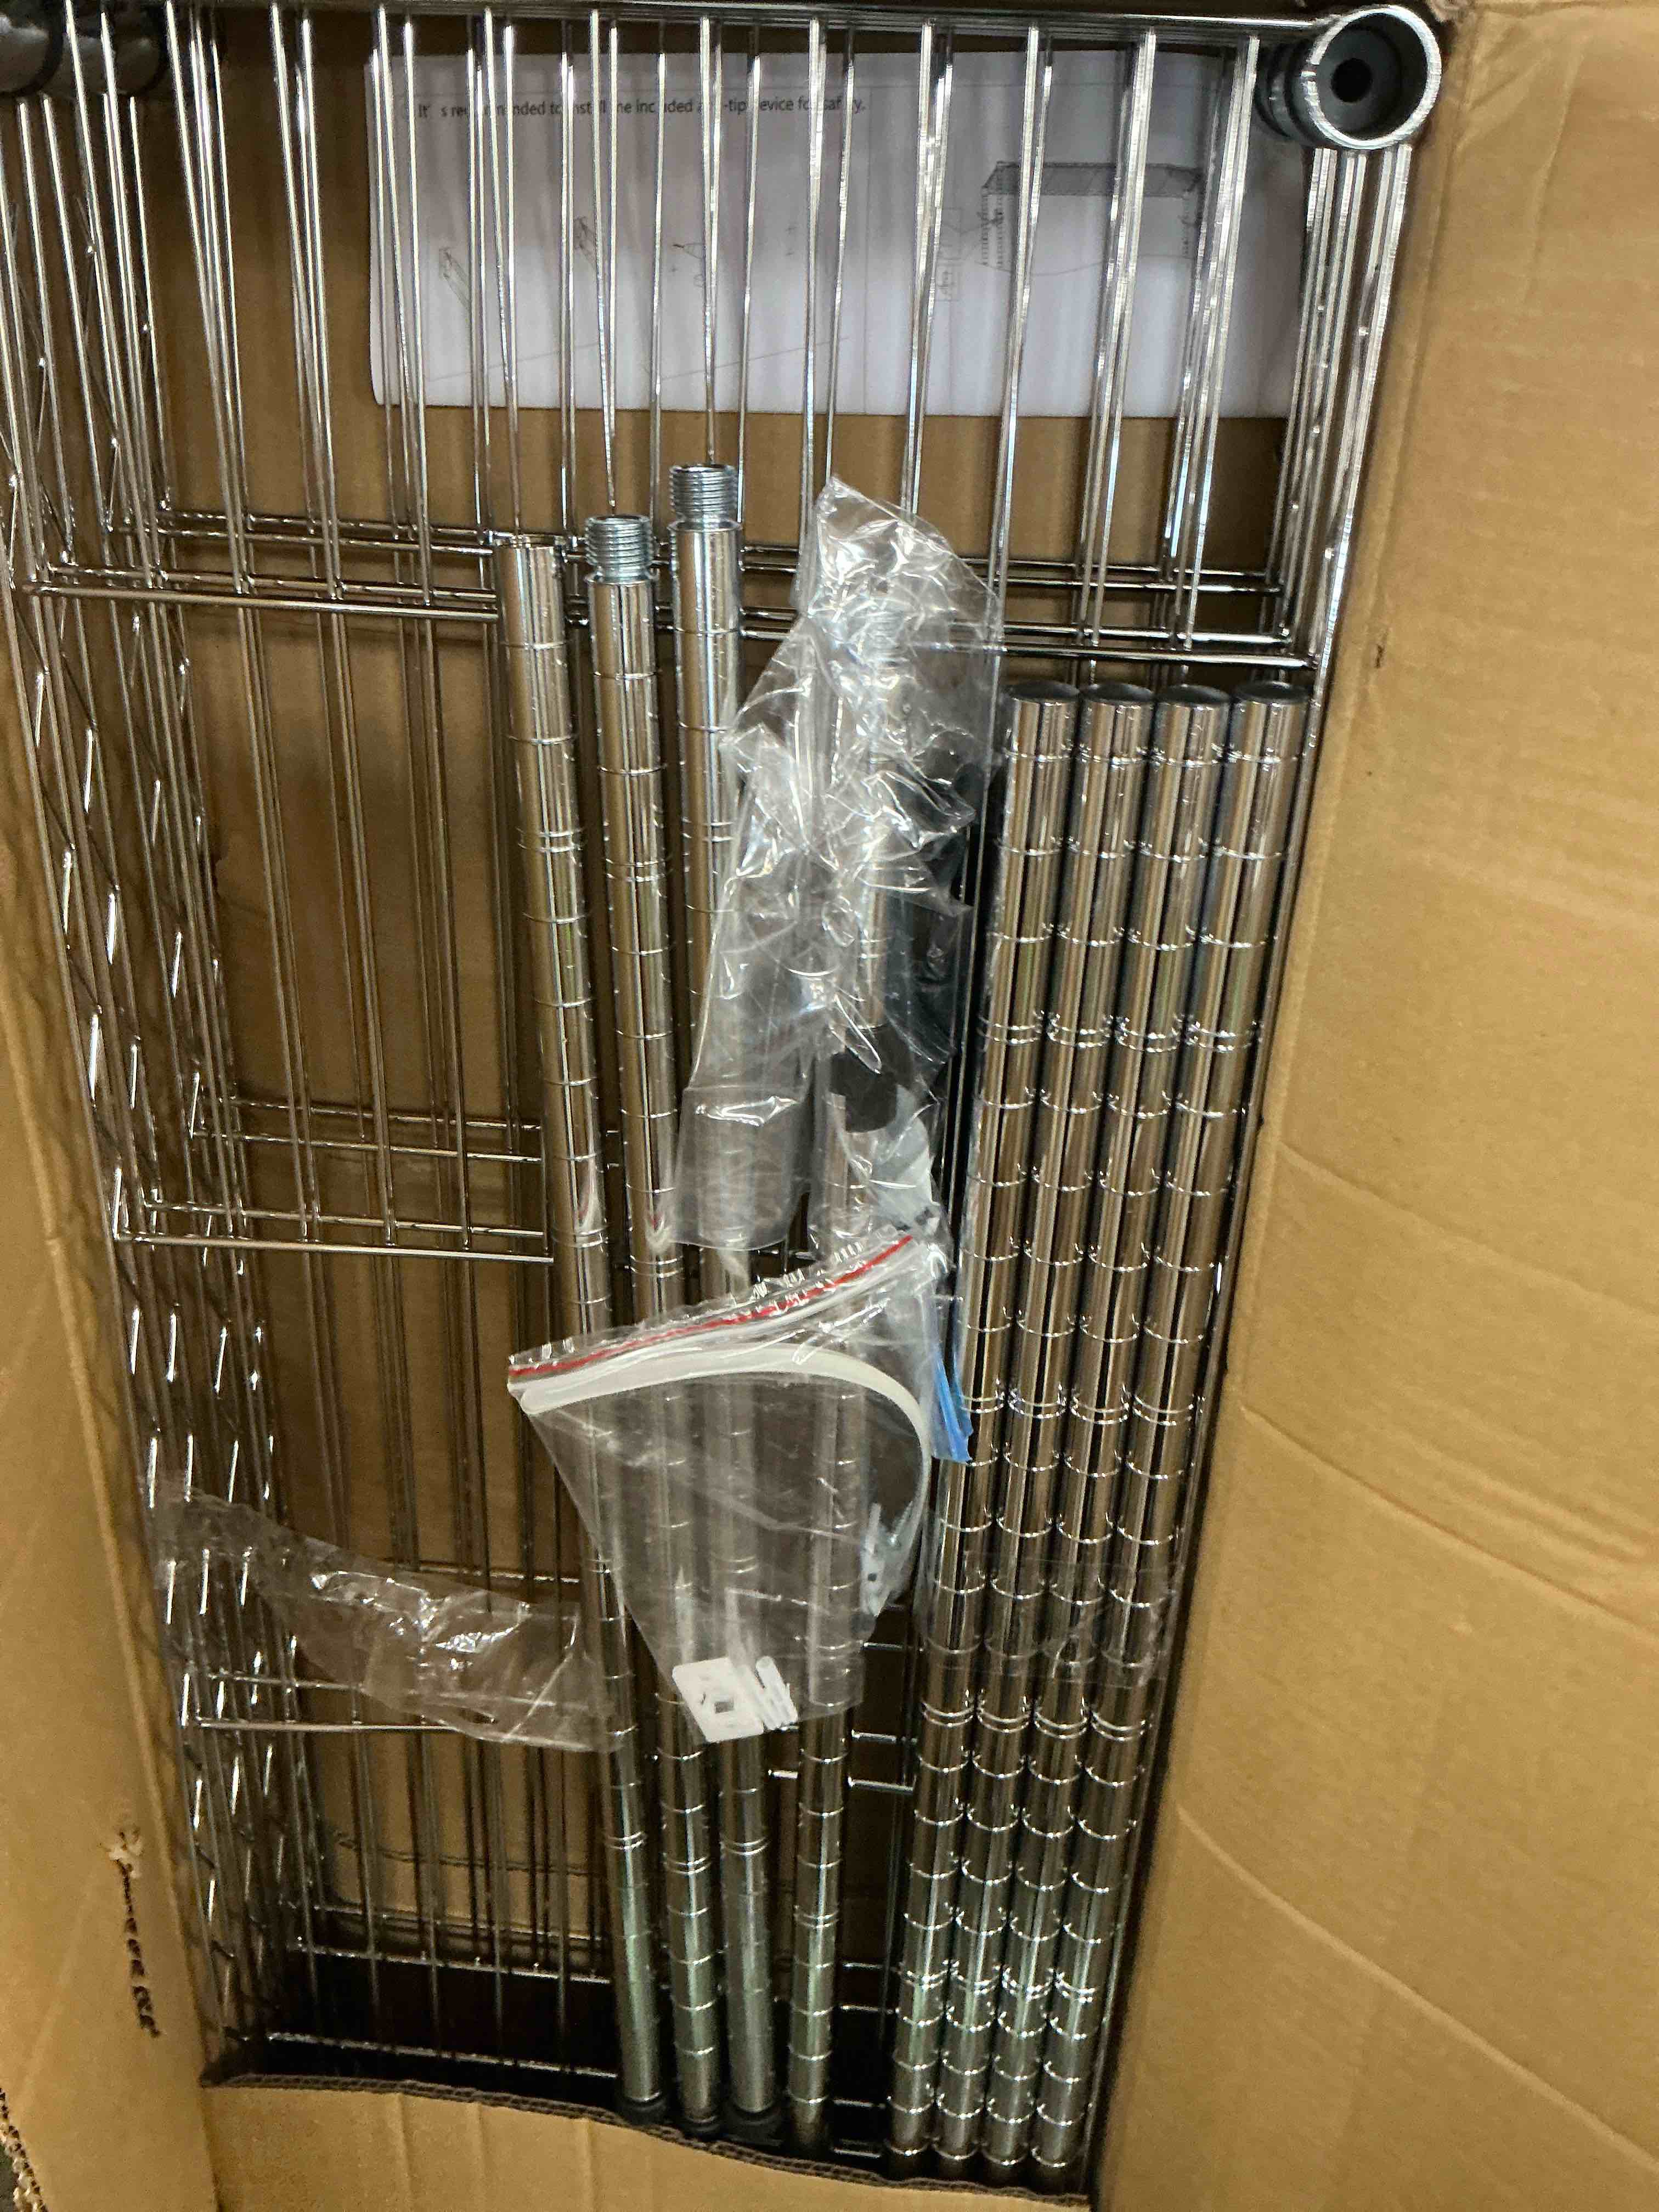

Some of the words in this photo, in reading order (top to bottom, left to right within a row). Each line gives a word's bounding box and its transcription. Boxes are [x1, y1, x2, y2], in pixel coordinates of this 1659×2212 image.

[568, 100, 606, 115] nstll
[612, 100, 631, 114] he
[636, 99, 693, 114] incded
[752, 97, 794, 111] evice
[798, 96, 815, 111] fo
[822, 96, 864, 115] safy.
